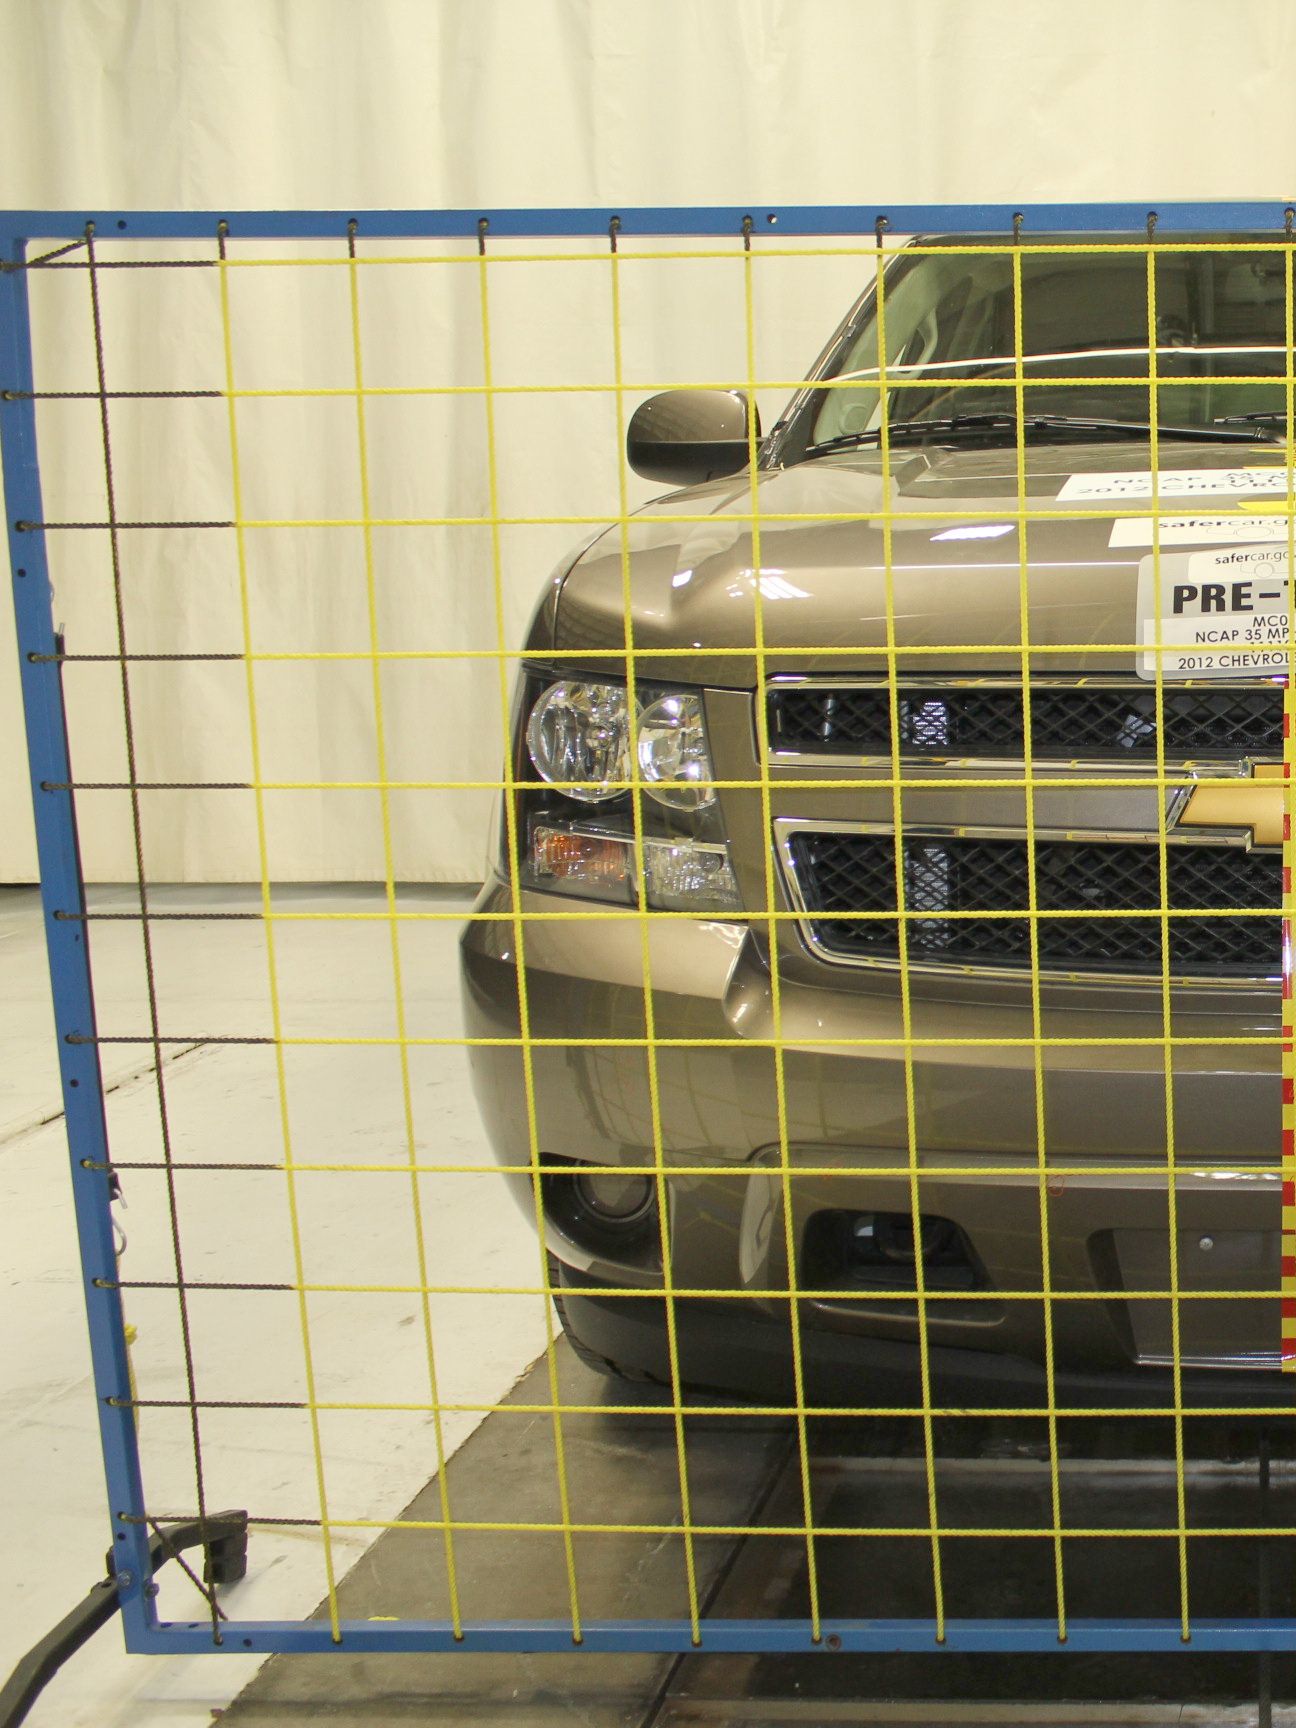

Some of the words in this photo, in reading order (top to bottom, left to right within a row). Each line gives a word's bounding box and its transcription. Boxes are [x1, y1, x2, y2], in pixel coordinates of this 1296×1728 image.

[1077, 486, 1149, 494] 2012
[1195, 629, 1240, 643] NCAP
[1244, 628, 1262, 640] 35
[1178, 656, 1214, 670] 2012
